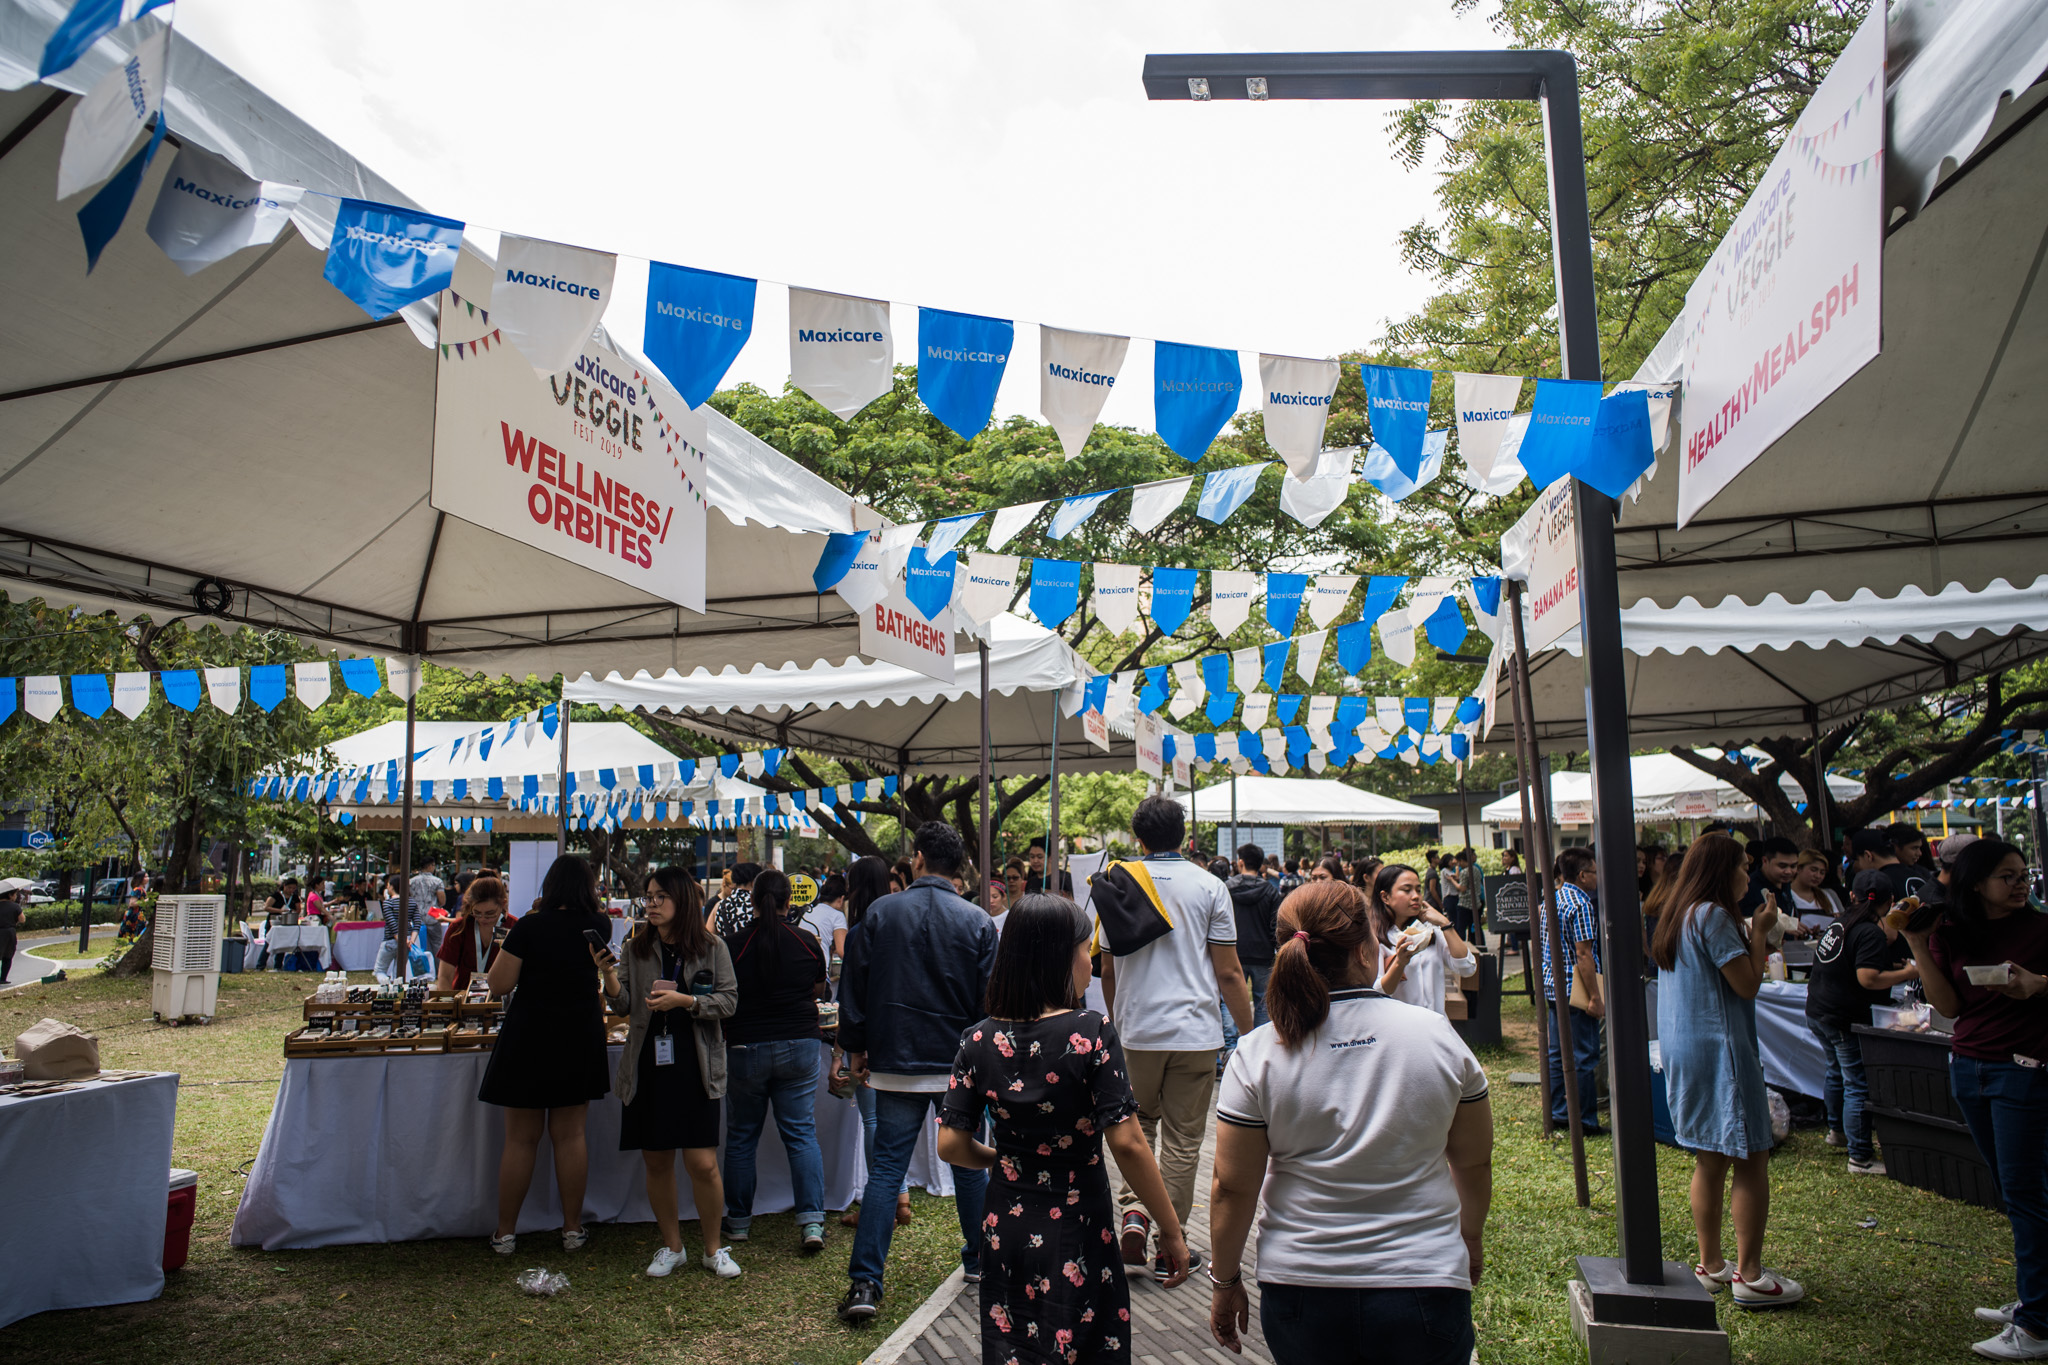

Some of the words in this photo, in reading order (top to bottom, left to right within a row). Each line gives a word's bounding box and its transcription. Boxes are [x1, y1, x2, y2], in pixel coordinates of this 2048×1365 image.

[173, 177, 279, 210] Maxicare
[1734, 168, 1791, 269] Maxicare
[345, 225, 448, 254] Maxicare
[1728, 192, 1796, 322] VEGGIE
[506, 269, 600, 301] Maxicare
[657, 301, 743, 331] Maxicare
[799, 328, 883, 343] Maxicare
[927, 345, 1006, 364] Maxicare
[574, 354, 637, 407] axicare
[1049, 363, 1115, 388] Maxicare
[1162, 378, 1234, 393] Maxicare
[1269, 390, 1332, 408] Maxicare
[1373, 396, 1430, 412] Maxicare
[550, 371, 643, 453] VEGGIE
[1535, 411, 1591, 426] Maxicare
[573, 420, 594, 445] FEST
[600, 436, 623, 460] 2019
[500, 421, 674, 545] WELLNESS/
[527, 483, 653, 570] ORBITES
[850, 561, 879, 571] axicar
[910, 567, 951, 578] Maxicare
[970, 575, 1011, 587] Maxicare
[1034, 577, 1075, 588] Maxicare
[1099, 585, 1135, 595] Maxicare
[1155, 586, 1190, 596] Maxicare
[1215, 590, 1248, 599] Maxicare
[1316, 586, 1348, 596] Maxicare
[1416, 590, 1444, 598] Maxicare
[1534, 578, 1564, 622] BANANA
[875, 603, 946, 657] BATHGEMS
